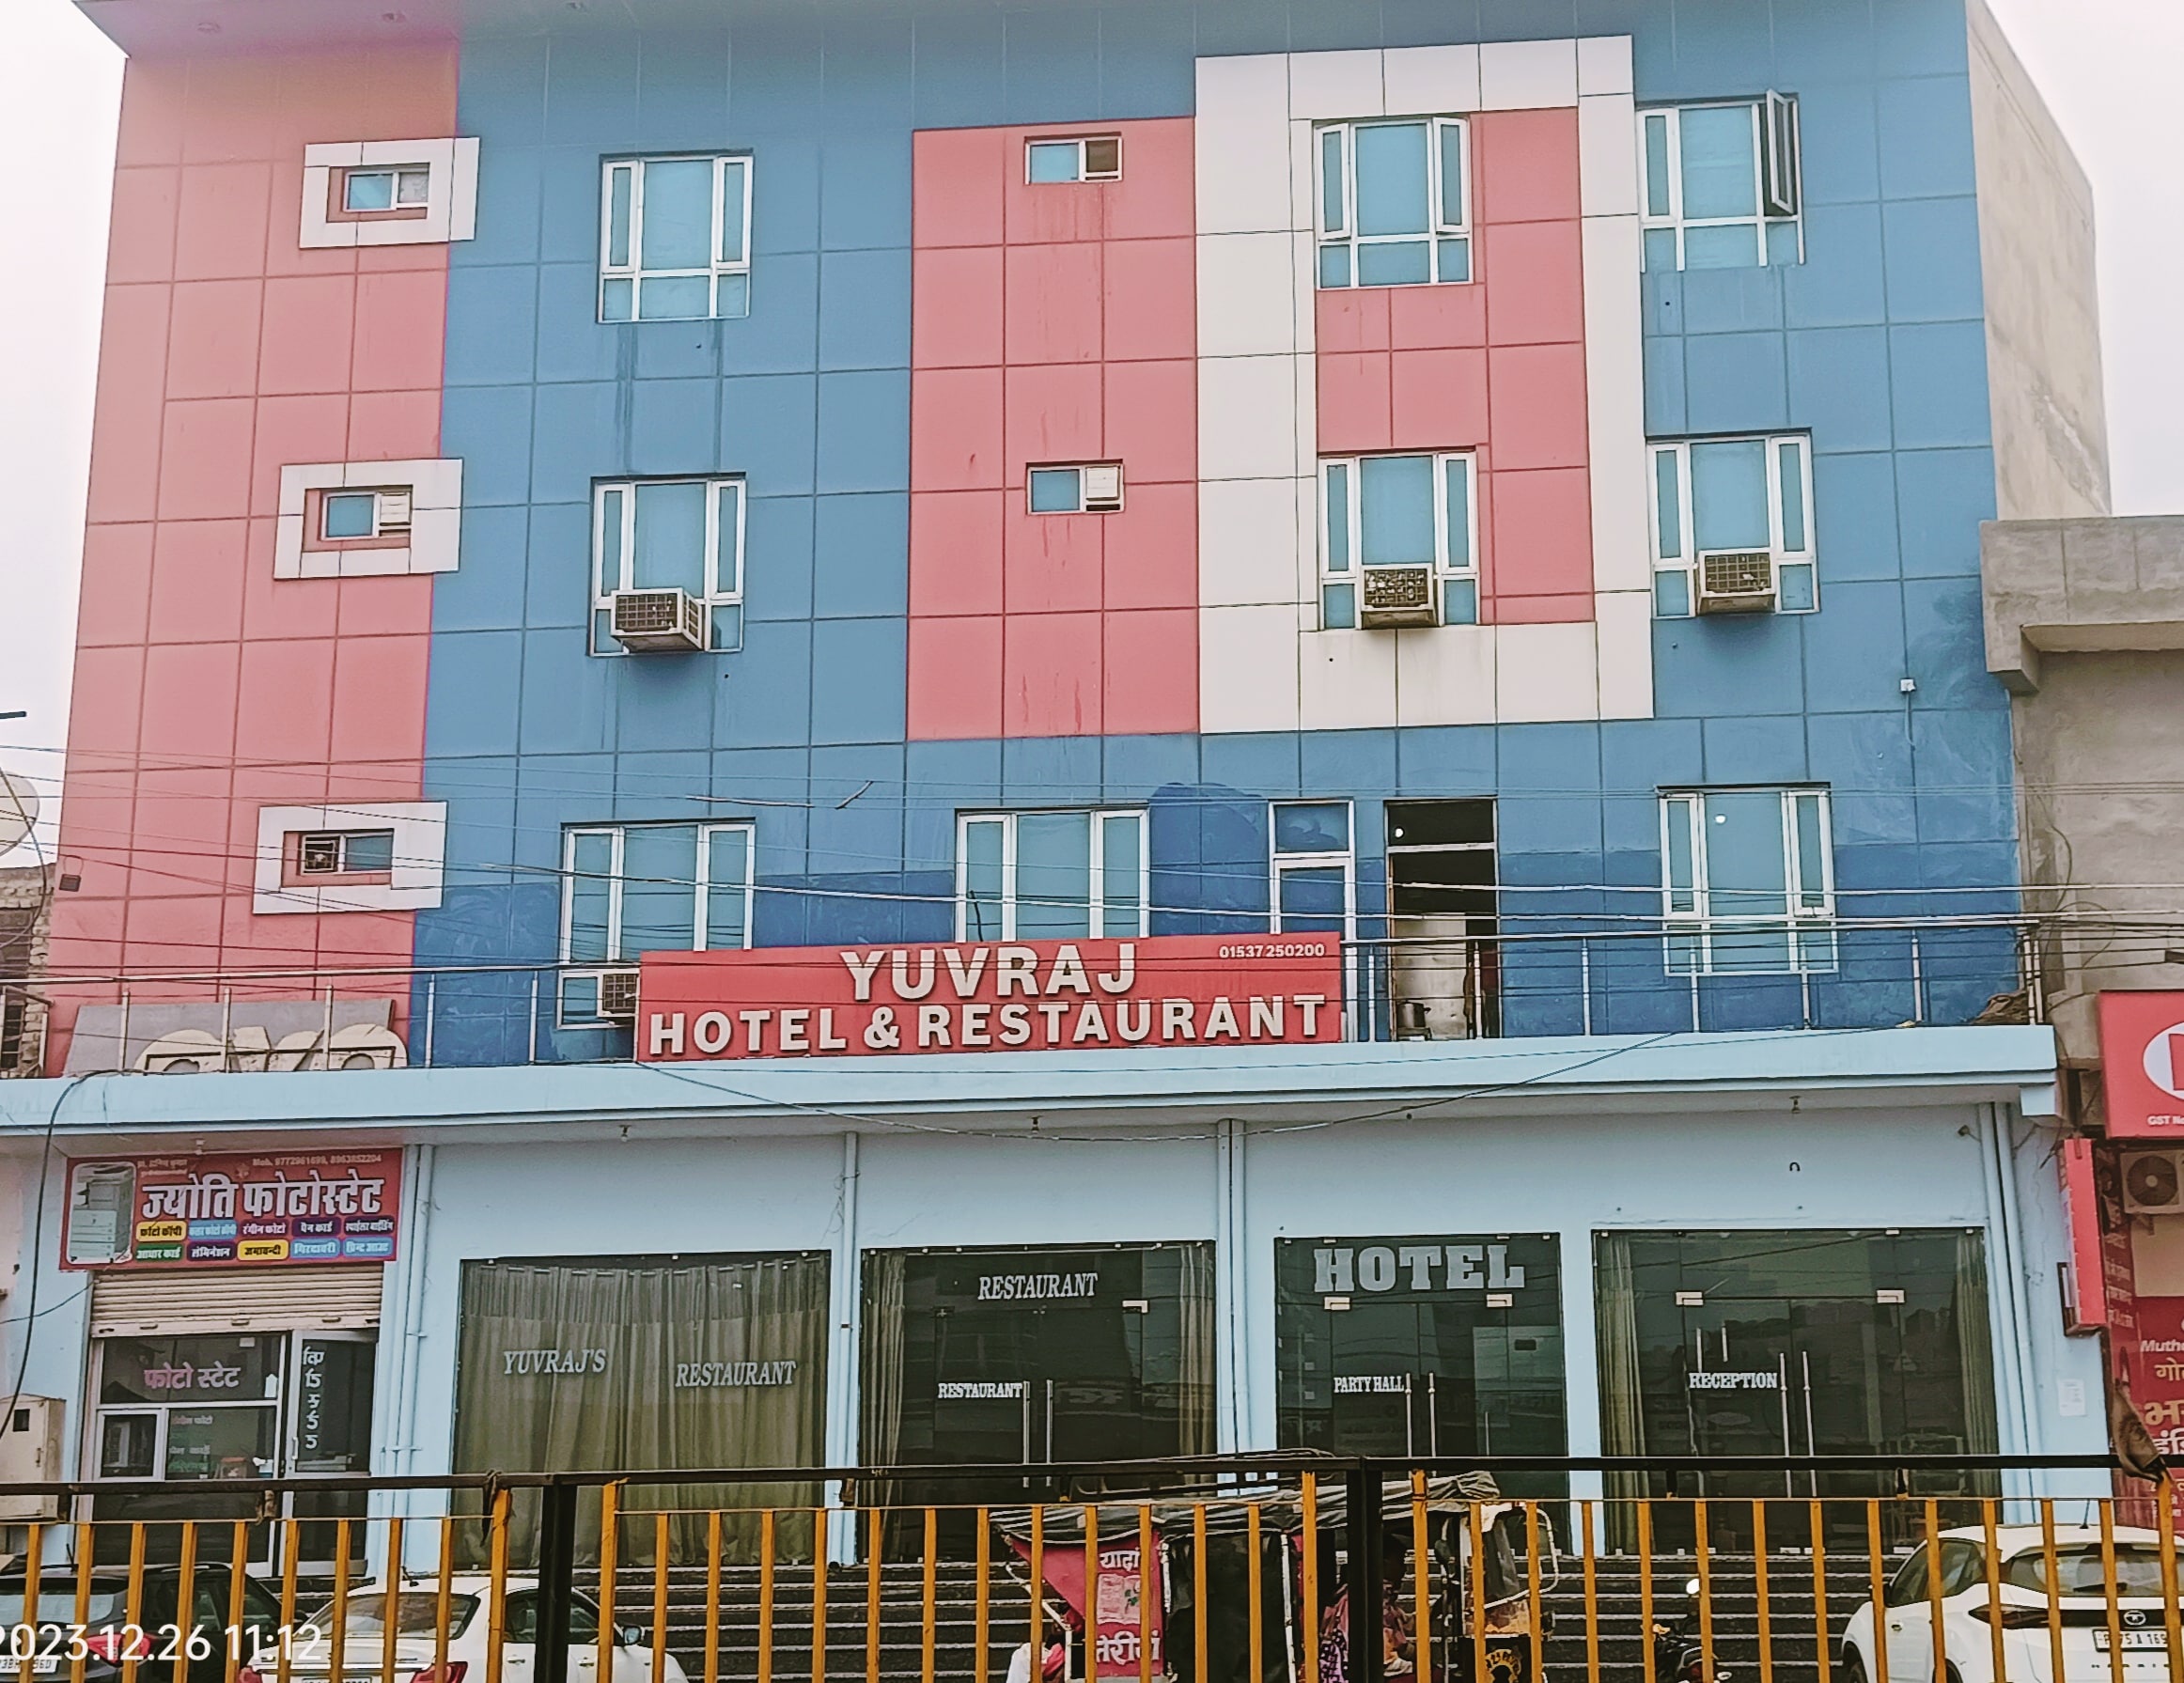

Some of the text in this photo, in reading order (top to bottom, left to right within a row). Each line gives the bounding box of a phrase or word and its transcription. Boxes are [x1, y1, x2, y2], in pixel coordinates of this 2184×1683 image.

[840, 943, 1137, 1001] YUVRAJ
[650, 994, 1325, 1054] HOTEL & RESTAURANT
[142, 1168, 384, 1219] ज्योति फोटोस्टेट
[1314, 1244, 1525, 1292] HOTEL
[977, 1273, 1098, 1300] RESTAURANT
[144, 1360, 242, 1389] फोटो स्टेट
[504, 1348, 606, 1375] YUVRAJ'S
[676, 1361, 796, 1387] RESTAURANT
[2153, 1356, 2184, 1381] गो
[938, 1382, 1022, 1398] RESTAURANT
[1334, 1375, 1405, 1393] PARTY HALL
[1689, 1372, 1778, 1389] RECEPTION
